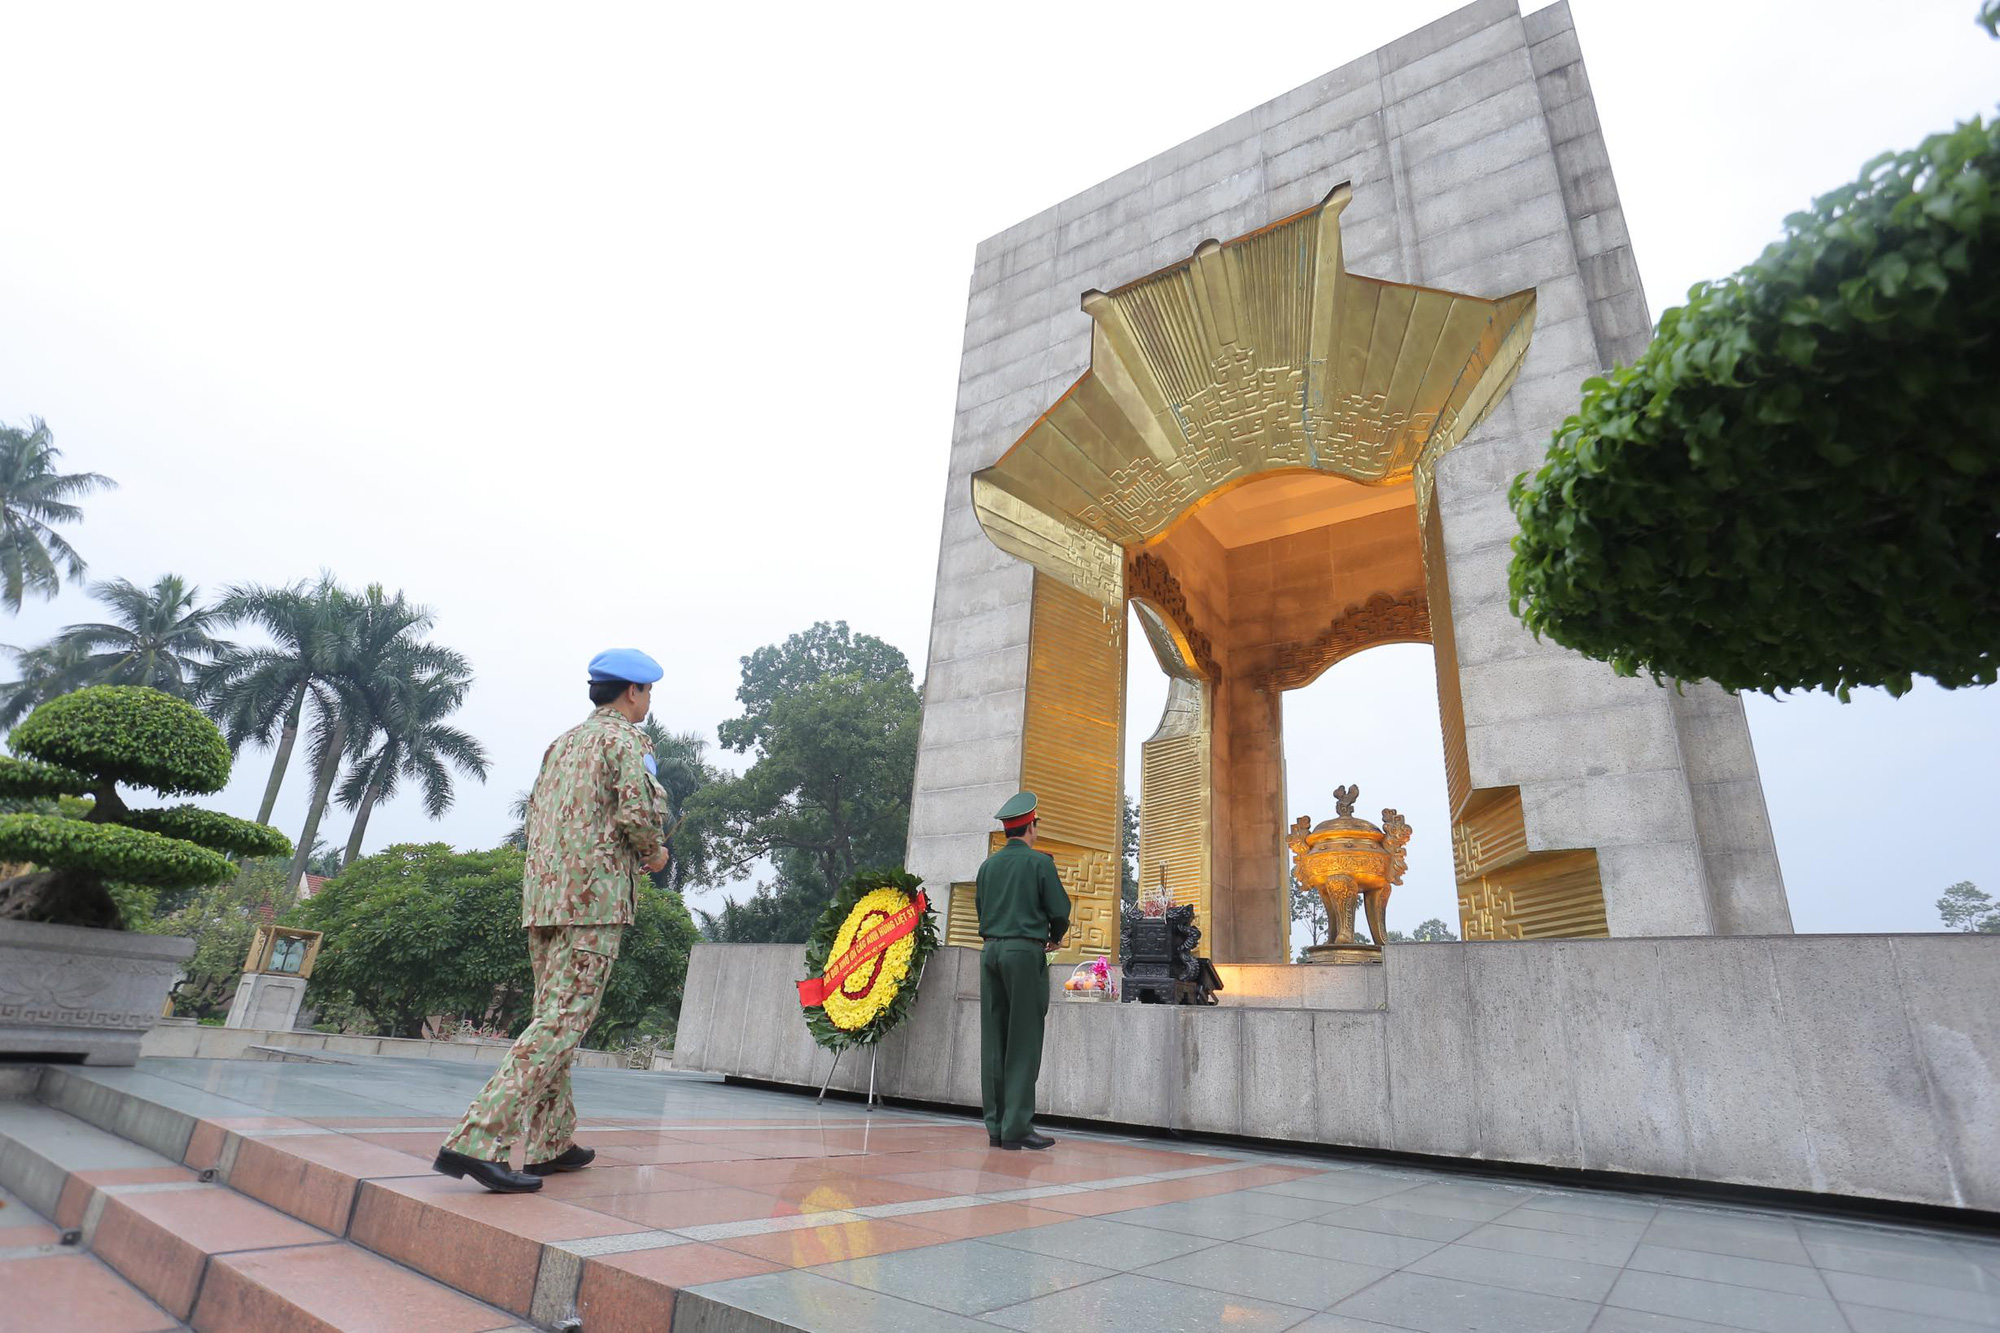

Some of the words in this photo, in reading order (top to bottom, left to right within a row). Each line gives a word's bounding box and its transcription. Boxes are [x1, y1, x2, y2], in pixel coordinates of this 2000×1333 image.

[866, 929, 880, 945] ANH
[877, 919, 896, 937] HÙNG
[893, 912, 908, 926] LIỆT
